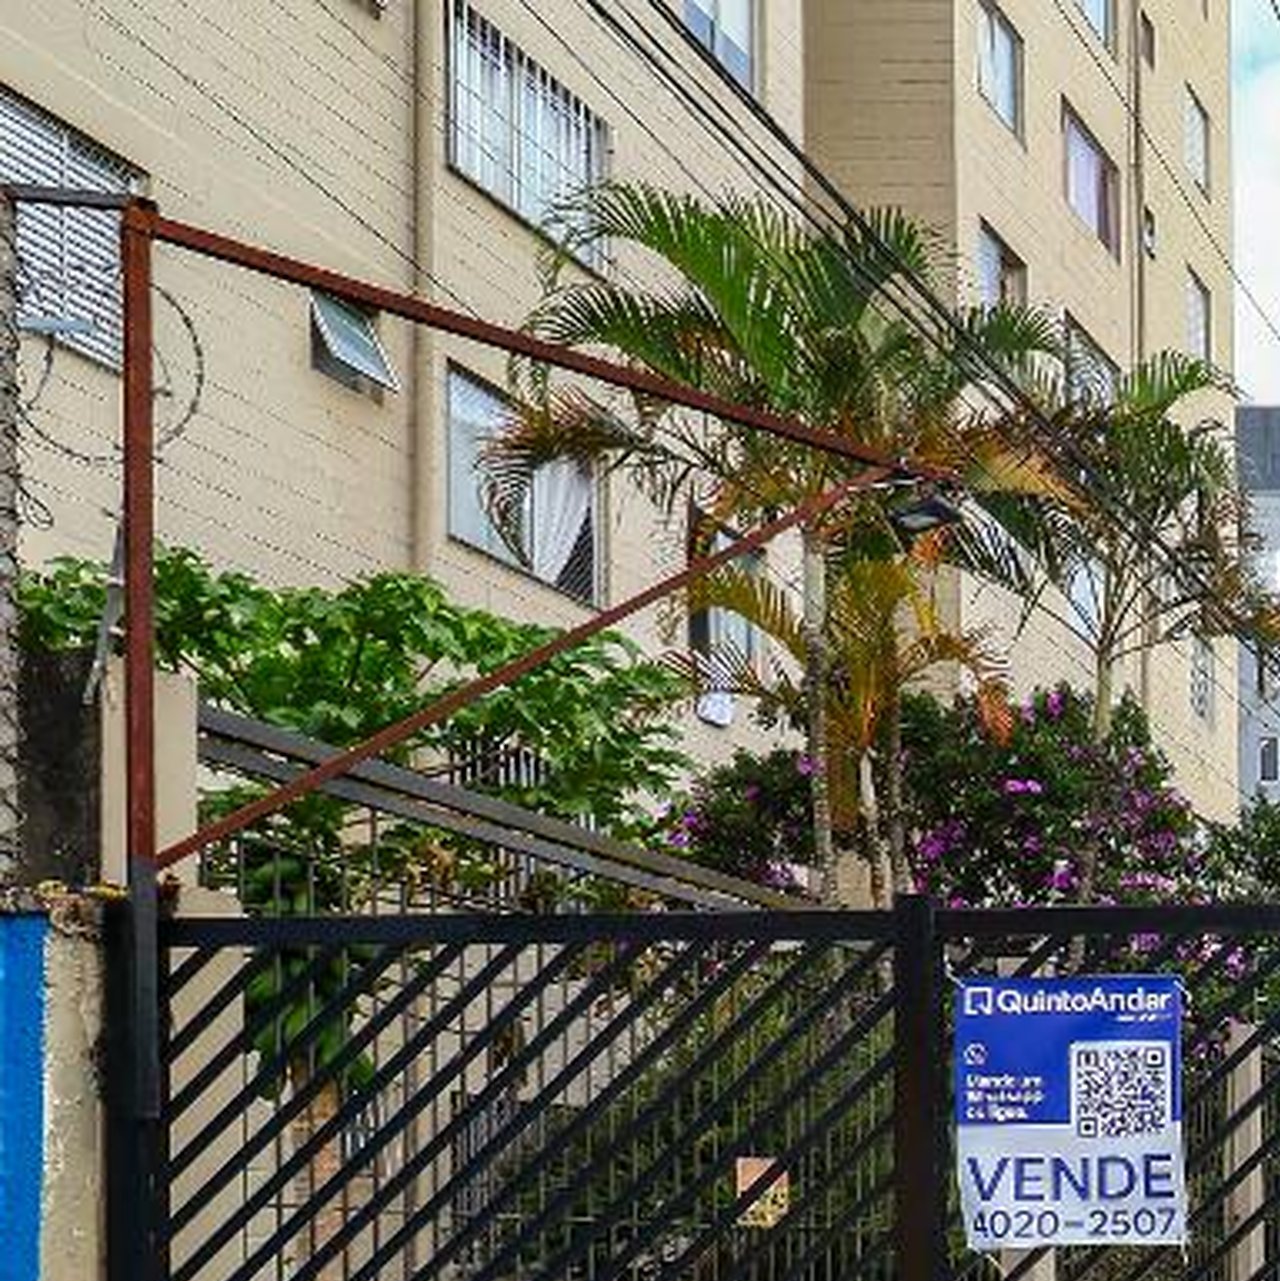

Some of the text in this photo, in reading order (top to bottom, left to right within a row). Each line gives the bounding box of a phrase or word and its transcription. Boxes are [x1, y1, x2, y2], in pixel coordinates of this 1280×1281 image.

[997, 988, 1171, 1014] QuintoAndar
[967, 1154, 1175, 1201] VENDE
[973, 1208, 1176, 1238] 4020-2507
